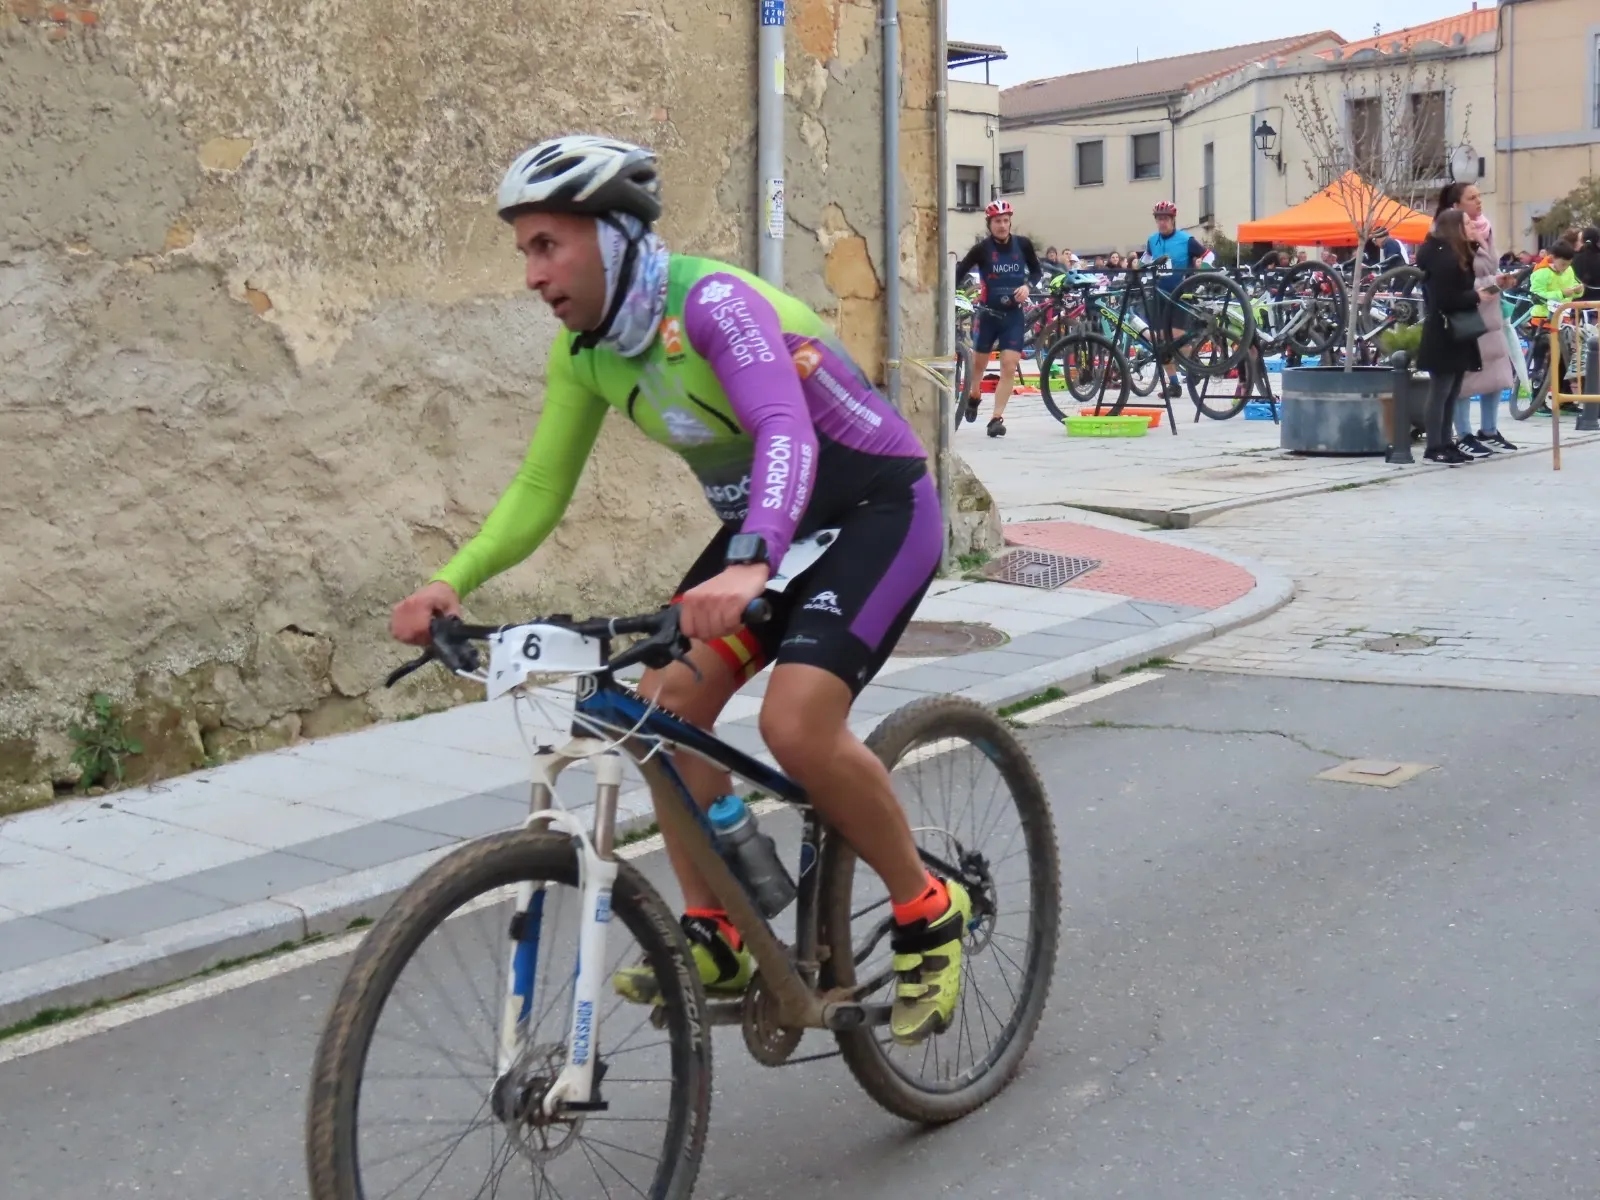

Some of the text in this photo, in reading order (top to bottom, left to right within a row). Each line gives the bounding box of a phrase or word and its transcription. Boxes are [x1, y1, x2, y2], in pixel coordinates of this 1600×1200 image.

[993, 264, 1019, 273] NACHO
[731, 297, 775, 362] turismo
[763, 435, 792, 509] SARDÓN
[522, 633, 542, 660] 6
[572, 1000, 593, 1066] ROCKSHOX
